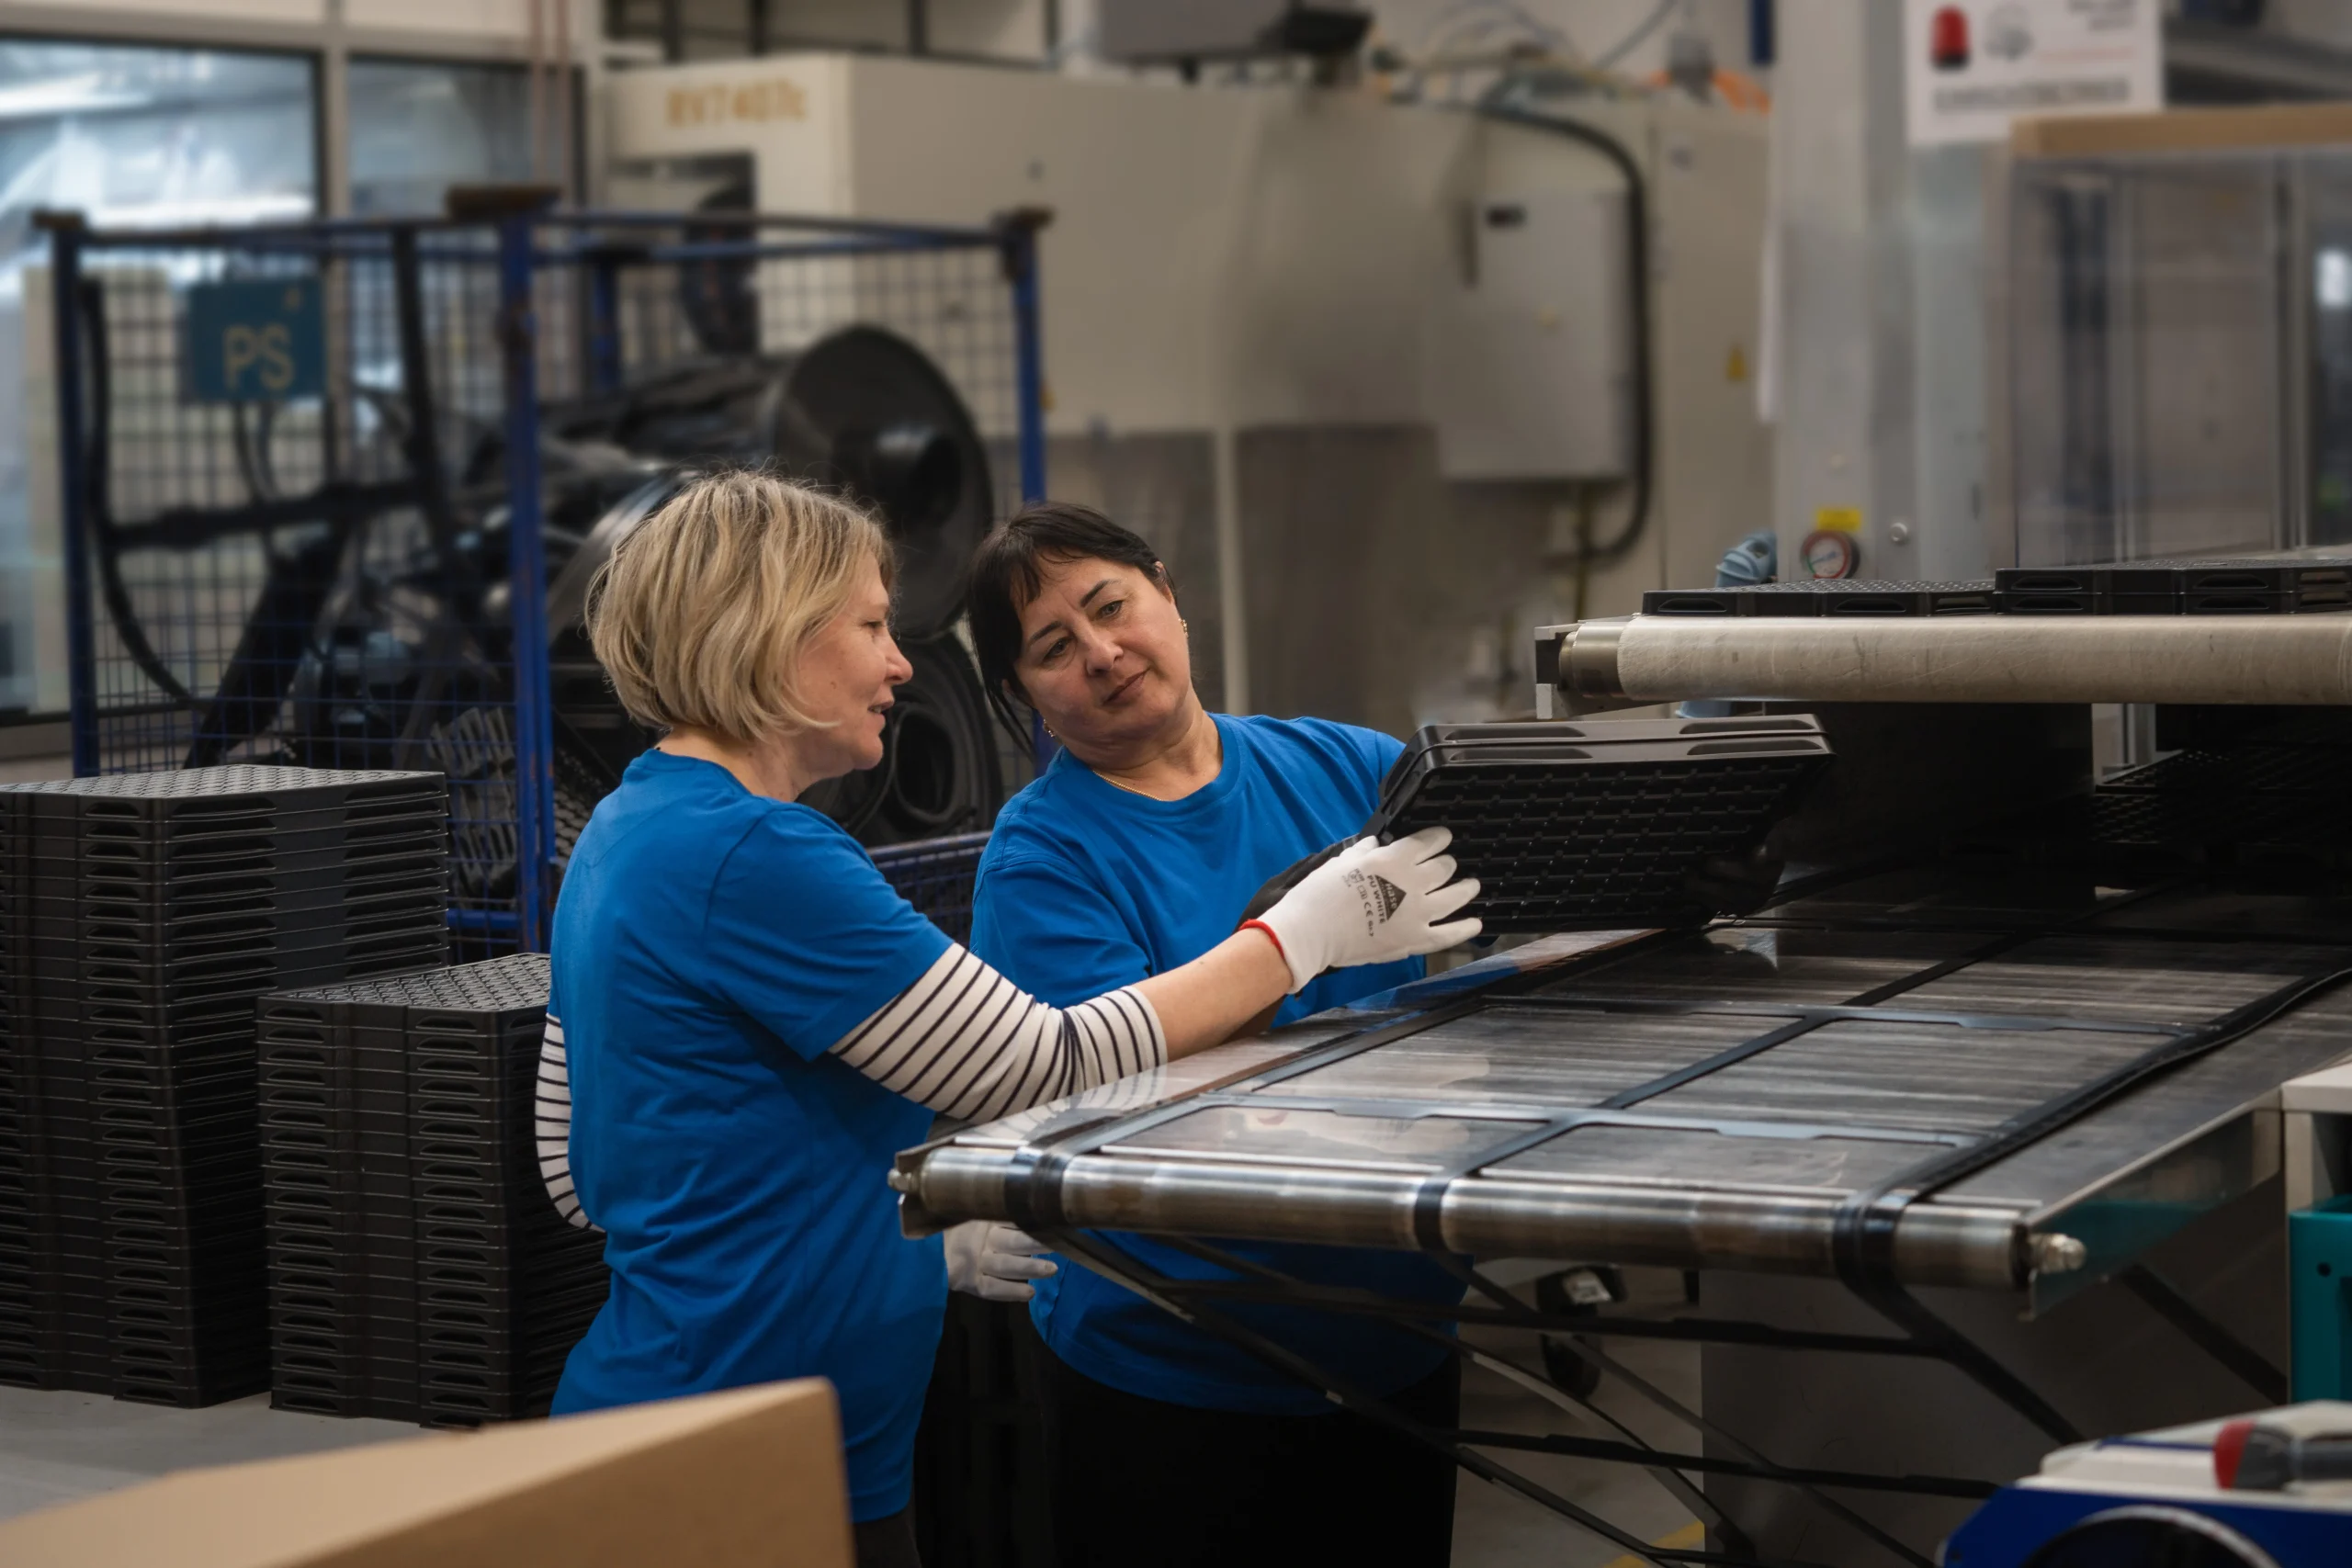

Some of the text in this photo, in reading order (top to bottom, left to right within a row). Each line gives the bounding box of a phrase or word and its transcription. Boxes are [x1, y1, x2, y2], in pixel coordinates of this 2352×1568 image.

[223, 324, 293, 390] PS
[1367, 874, 1376, 887] PU
[1374, 889, 1385, 923] WHITE
[1385, 884, 1397, 908] Hase
